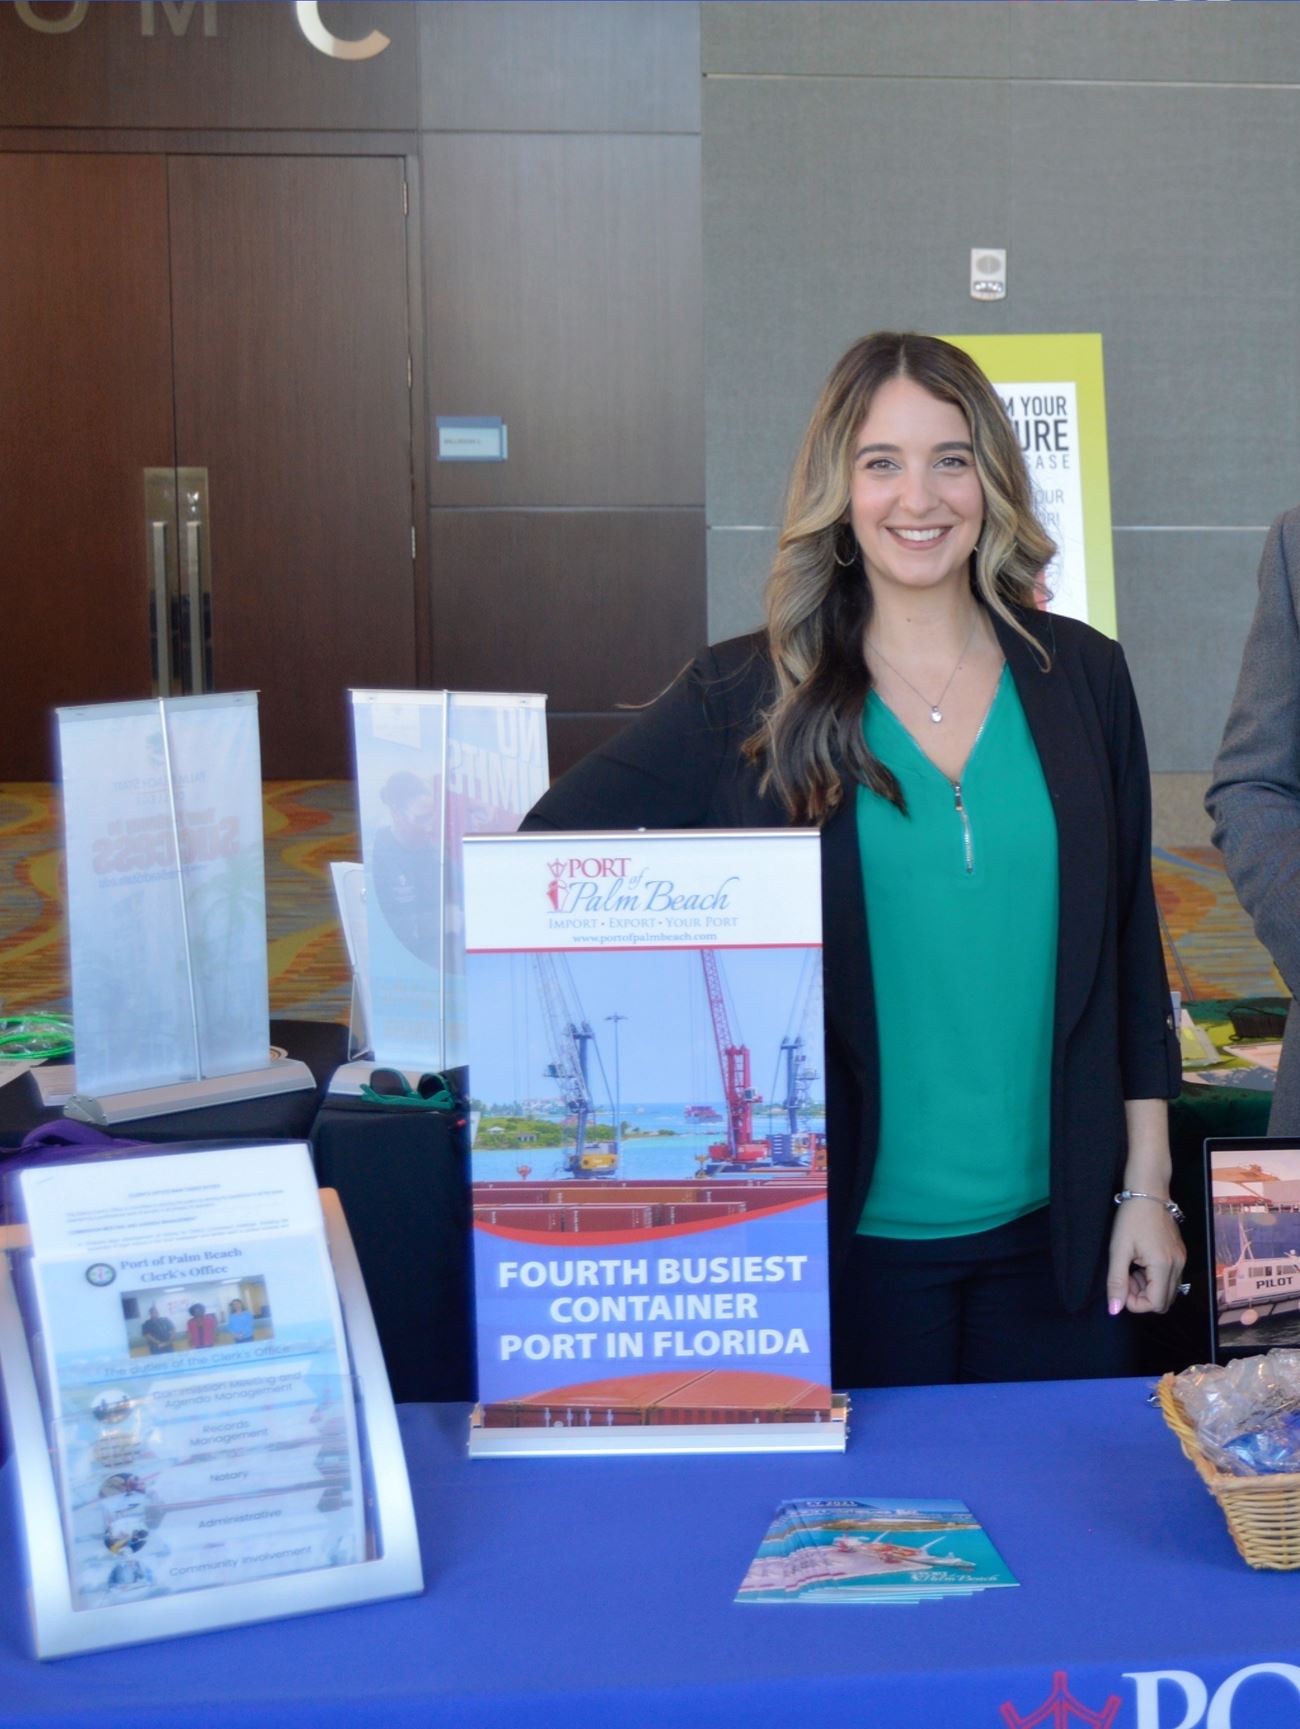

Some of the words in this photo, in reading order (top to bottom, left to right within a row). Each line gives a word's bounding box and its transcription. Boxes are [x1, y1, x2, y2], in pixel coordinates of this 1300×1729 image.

[1020, 396, 1067, 417] YOUR
[568, 858, 632, 878] PORT
[628, 866, 649, 890] of
[568, 878, 641, 913] Palm
[643, 876, 740, 912] Beach
[120, 1258, 149, 1271] Port
[151, 1255, 166, 1267] of
[168, 1252, 201, 1265] Palm
[203, 1247, 243, 1261] Beach
[189, 1264, 229, 1278] Office
[499, 1259, 648, 1288] FOURTH
[659, 1255, 808, 1284] BUSIEST
[1256, 1276, 1295, 1289] PILOT
[550, 1293, 758, 1323] CONTAINER
[501, 1332, 598, 1361] PORT
[607, 1331, 644, 1358] IN
[654, 1328, 810, 1357] FLORIDA
[210, 1470, 249, 1482] Notary
[198, 1509, 283, 1529] Administrative
[169, 1557, 239, 1577] Community
